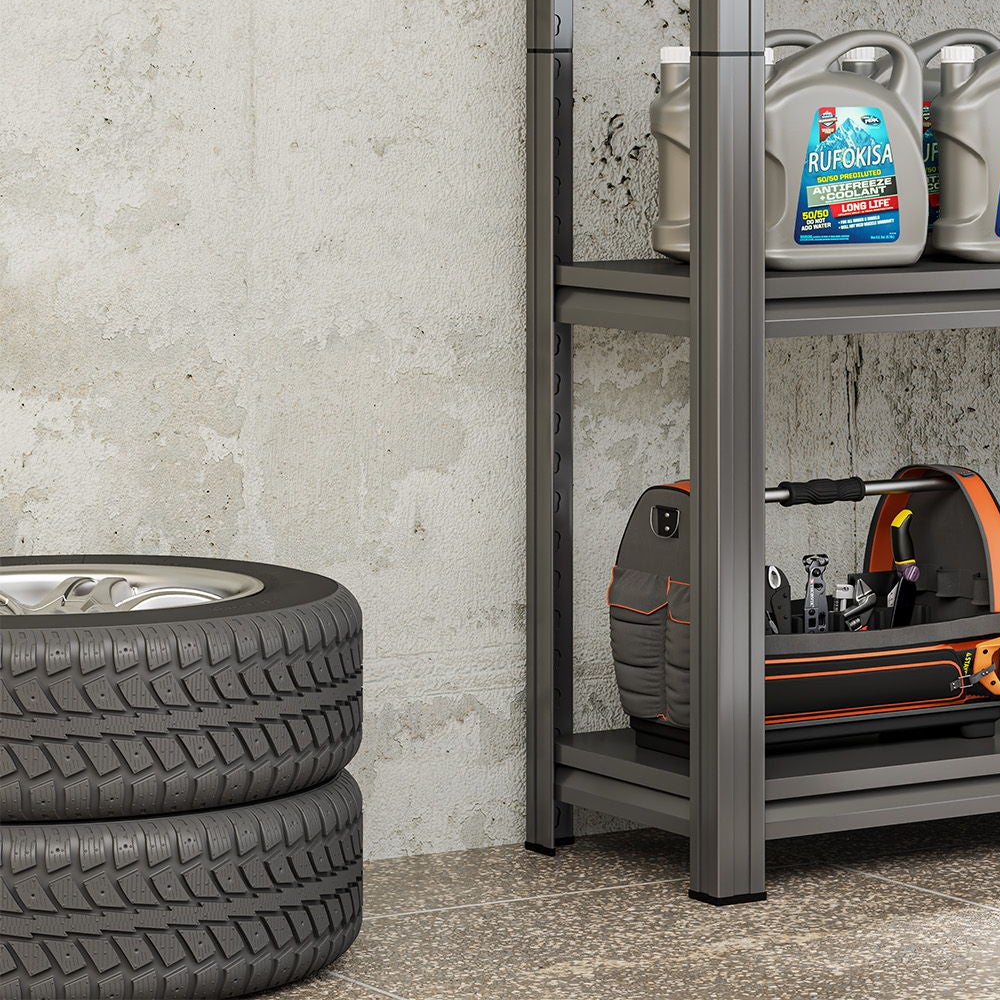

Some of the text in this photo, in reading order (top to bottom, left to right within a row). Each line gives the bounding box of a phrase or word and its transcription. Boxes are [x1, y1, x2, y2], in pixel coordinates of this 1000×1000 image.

[808, 144, 893, 173] RUFOKISA
[839, 169, 882, 180] PREDILUTED
[812, 177, 892, 195] ANTIFREEZE
[841, 200, 867, 213] LONG
[868, 198, 891, 209] LIFE
[802, 209, 829, 220] 50/50
[813, 222, 832, 230] WATER
